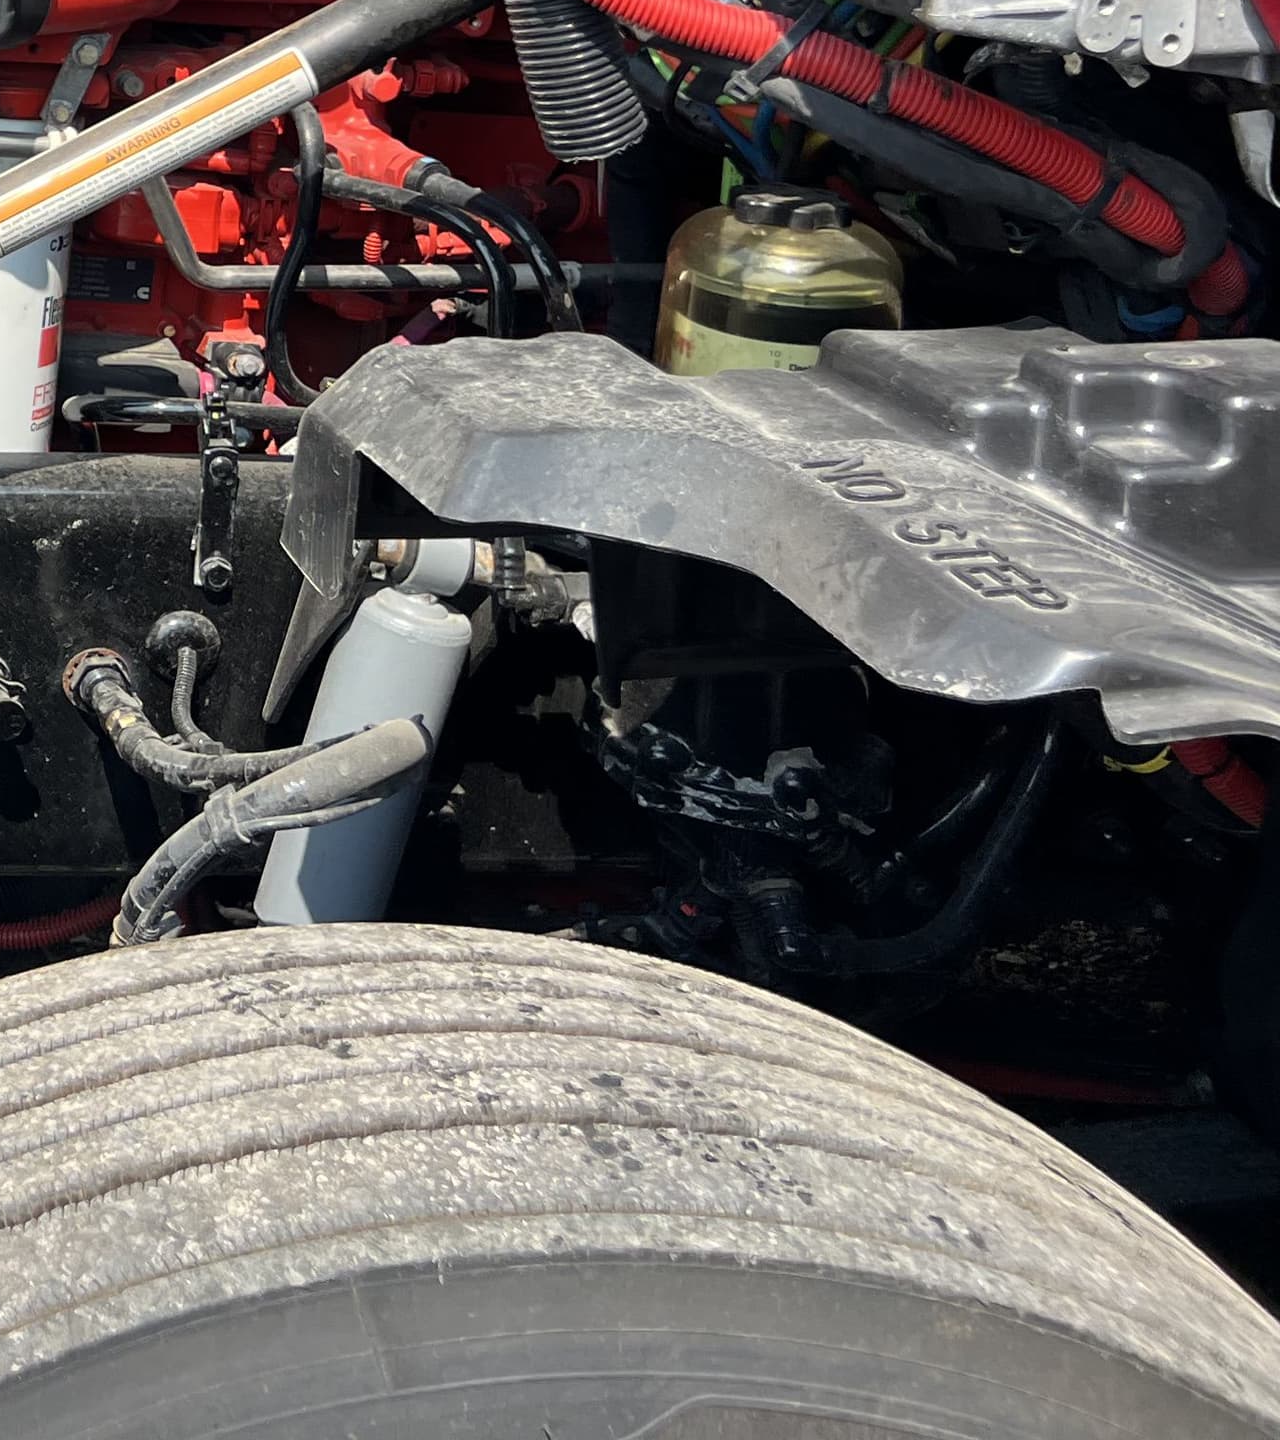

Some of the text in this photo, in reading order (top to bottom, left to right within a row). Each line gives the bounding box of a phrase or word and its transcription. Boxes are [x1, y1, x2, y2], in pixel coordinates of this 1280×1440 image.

[114, 116, 182, 160] WARNING
[769, 350, 782, 359] 10
[801, 456, 1069, 611] NO STEP
